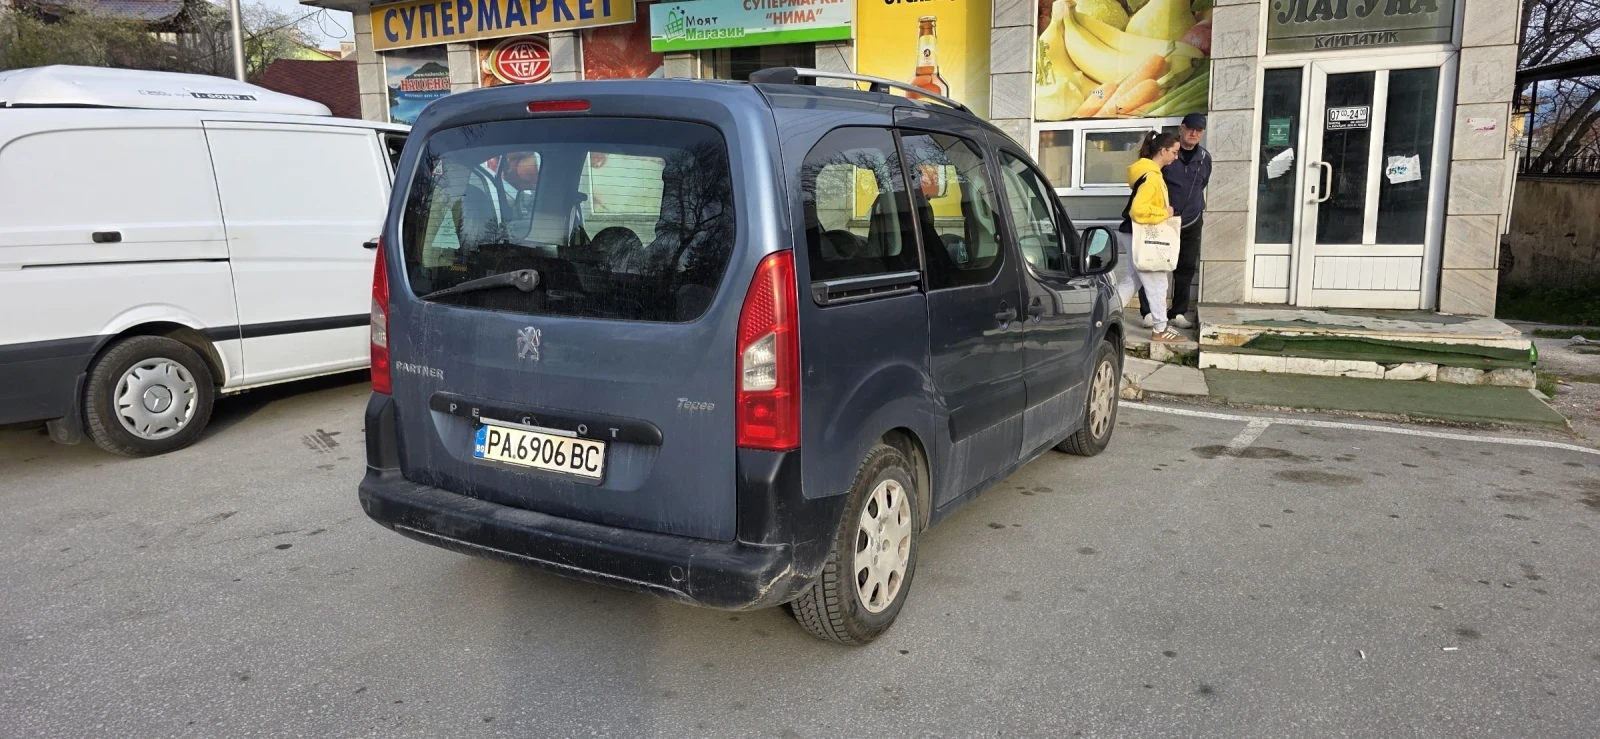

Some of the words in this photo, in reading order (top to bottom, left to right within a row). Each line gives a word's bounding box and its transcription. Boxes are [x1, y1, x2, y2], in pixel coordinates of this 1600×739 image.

[743, 0, 844, 10] СУПЕРМ
[685, 27, 745, 40] Магазин
[1314, 31, 1399, 48] КЛИМАТИК
[509, 61, 541, 76] KEN
[395, 360, 444, 380] PARTNER
[677, 397, 715, 411] Tepee
